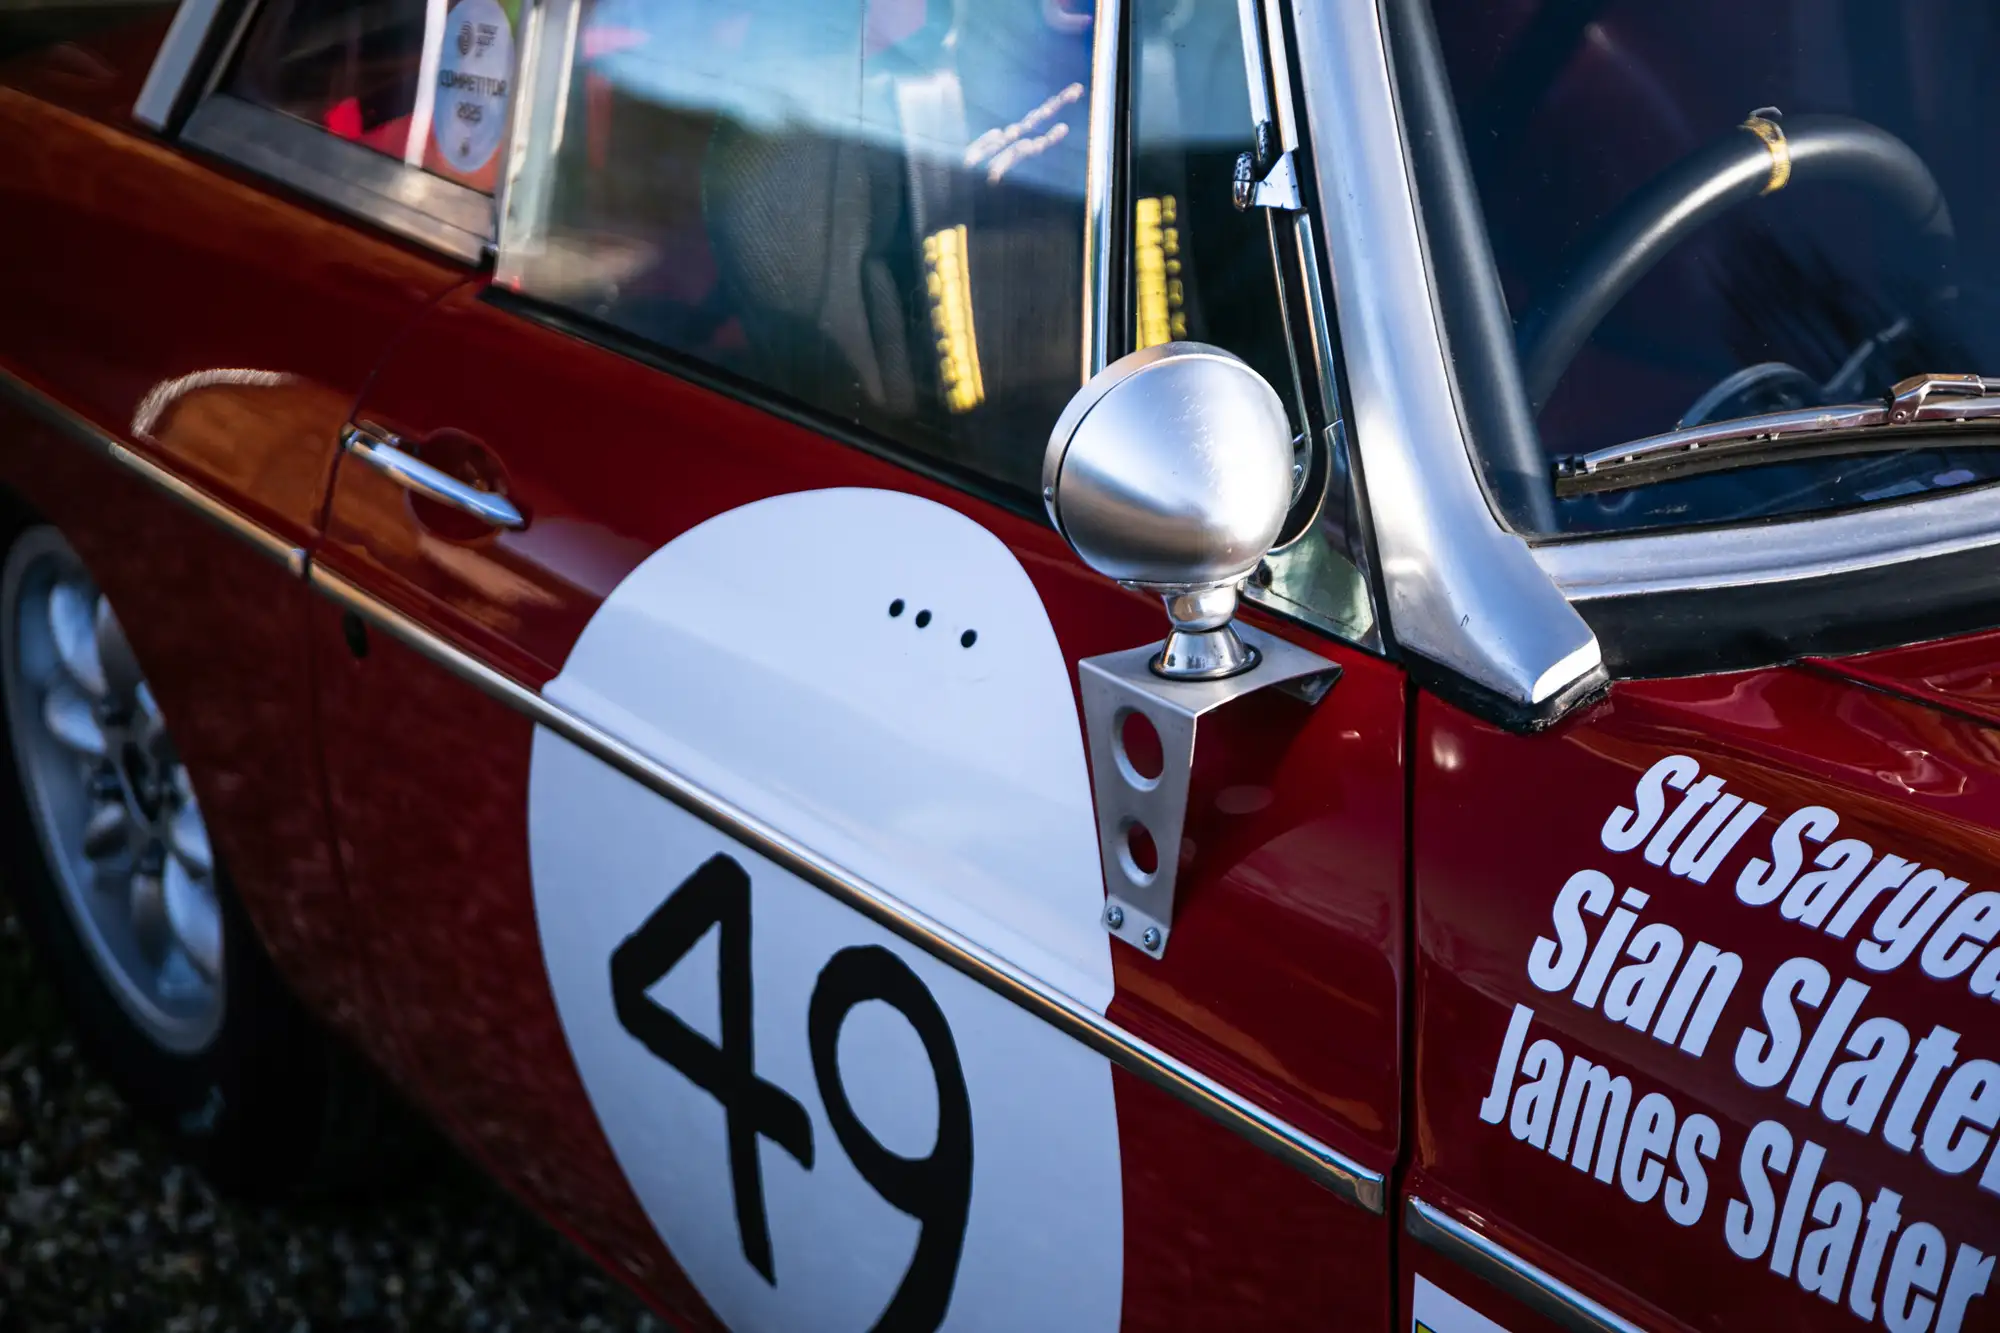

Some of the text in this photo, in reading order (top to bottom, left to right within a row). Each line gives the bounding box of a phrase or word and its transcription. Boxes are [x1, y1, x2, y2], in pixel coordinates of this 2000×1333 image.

[440, 69, 508, 97] COMPETITOR
[1601, 754, 1767, 884] Stu
[609, 851, 974, 1333] 49
[1480, 1003, 1997, 1333] James Slater
[1527, 869, 2000, 1197] Sian Slate
